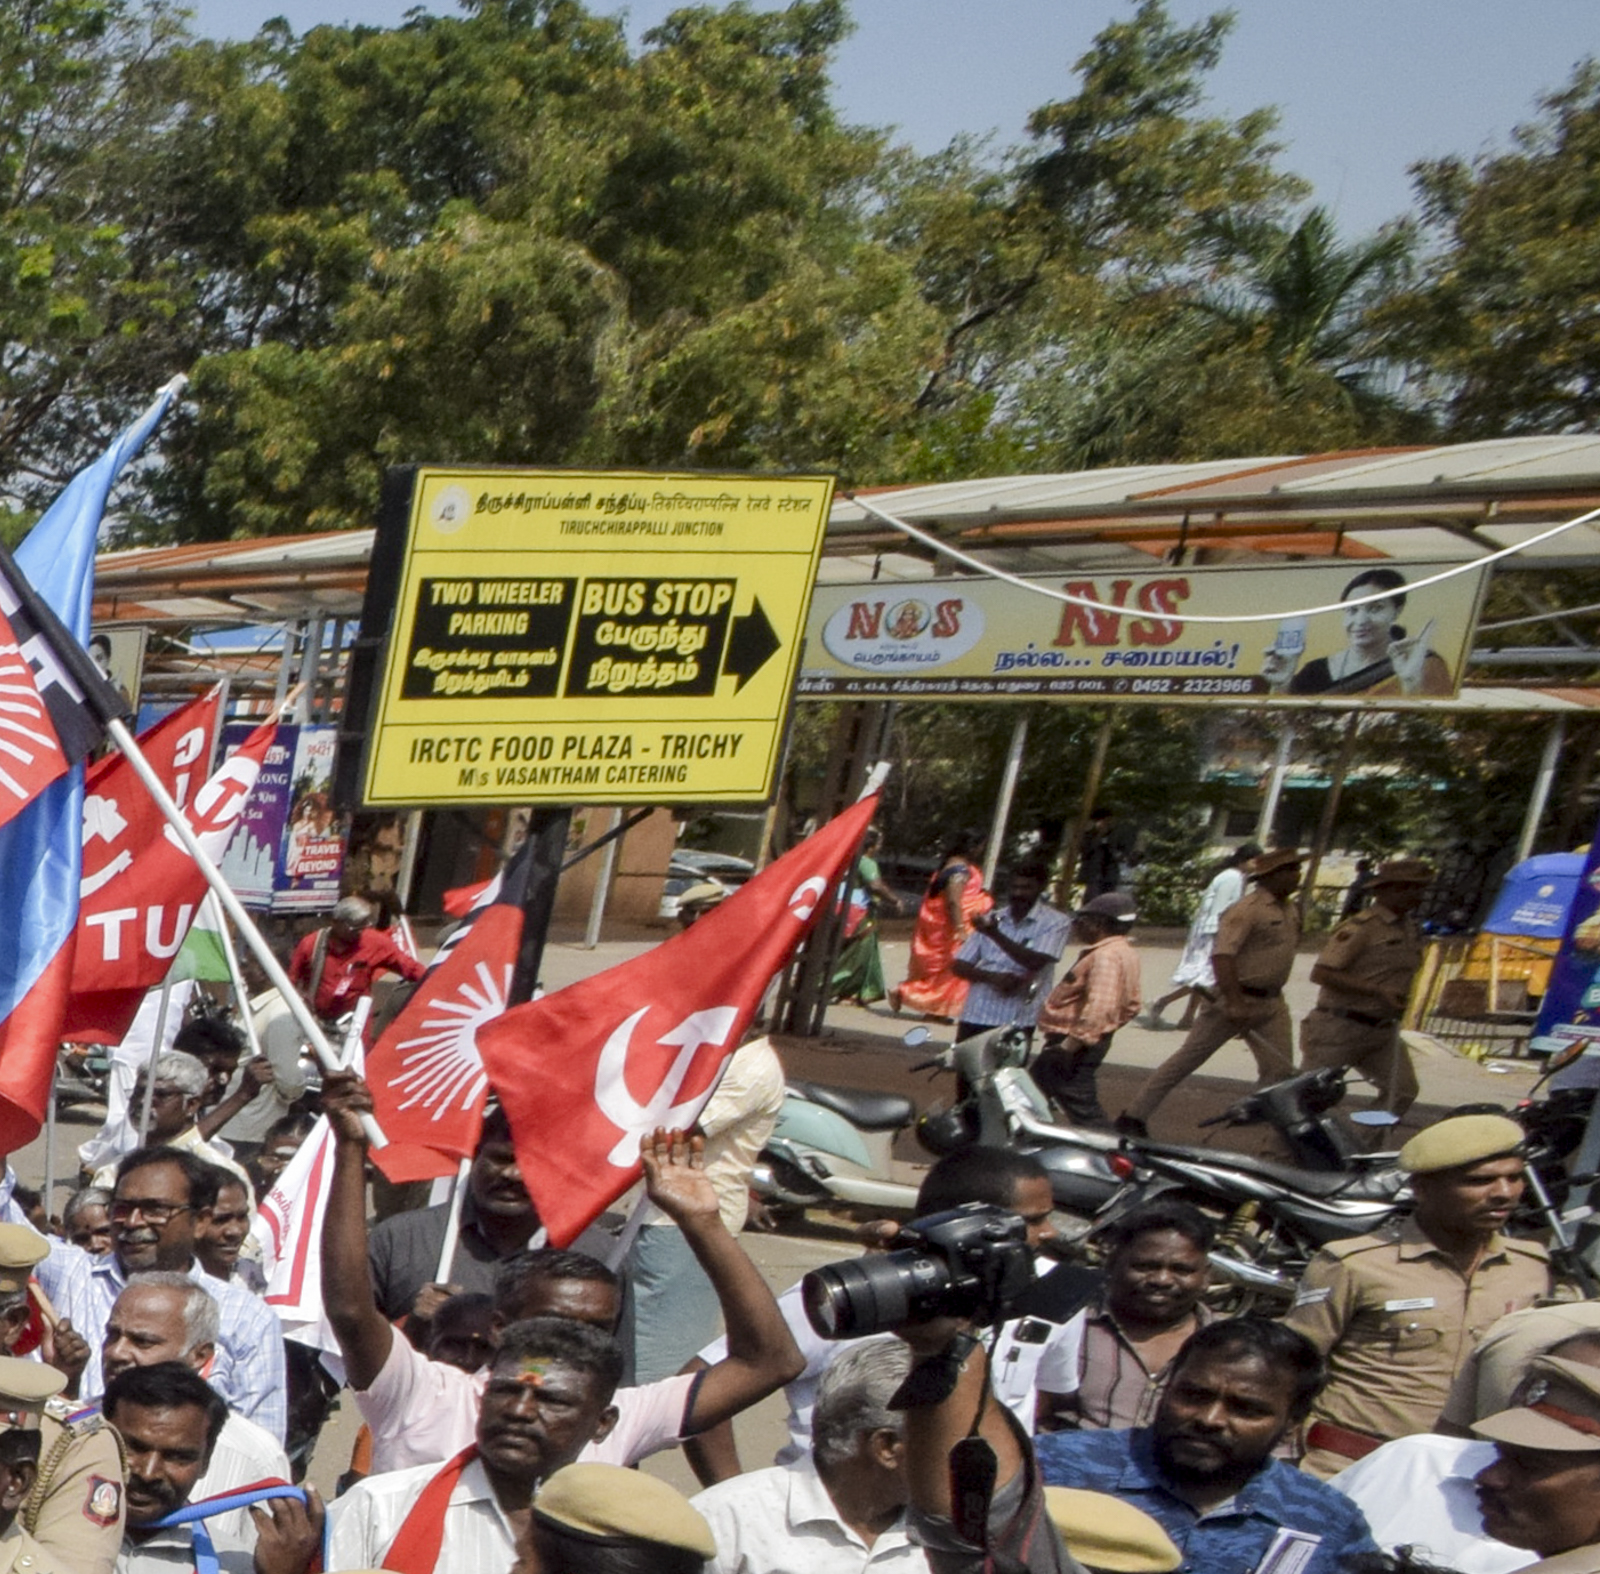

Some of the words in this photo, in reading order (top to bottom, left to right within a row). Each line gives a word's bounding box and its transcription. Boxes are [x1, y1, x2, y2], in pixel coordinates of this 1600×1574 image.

[474, 492, 591, 515] திருச்சிராப்பள்ளி
[559, 520, 668, 536] TIRUCHCHIRAPPALLI
[671, 521, 724, 536] JUNCTION
[431, 582, 473, 605] TWO
[478, 582, 564, 605] WHEELER
[582, 583, 646, 615] BUS
[653, 583, 732, 615] STOP
[449, 613, 529, 636] PARKING
[1052, 578, 1191, 648] NS
[595, 619, 709, 651] பேருந்து
[412, 648, 492, 670] இருசக்கர
[493, 647, 558, 667] வாகனம்
[852, 650, 942, 667] பெருங்காயம்
[1101, 640, 1241, 669] சமையல்!
[586, 656, 699, 689] நிறுத்தம்
[1131, 678, 1170, 692] 0452
[1183, 678, 1252, 692] 2323966
[409, 738, 483, 764] IRCTC
[490, 736, 554, 762] FOOD
[561, 735, 633, 761] PLAZA
[660, 734, 744, 759] TRICHY
[496, 766, 599, 787] VASANTHAM
[604, 765, 688, 784] CATERING
[305, 843, 341, 857] TRAVEL
[298, 859, 338, 873] BEYOND
